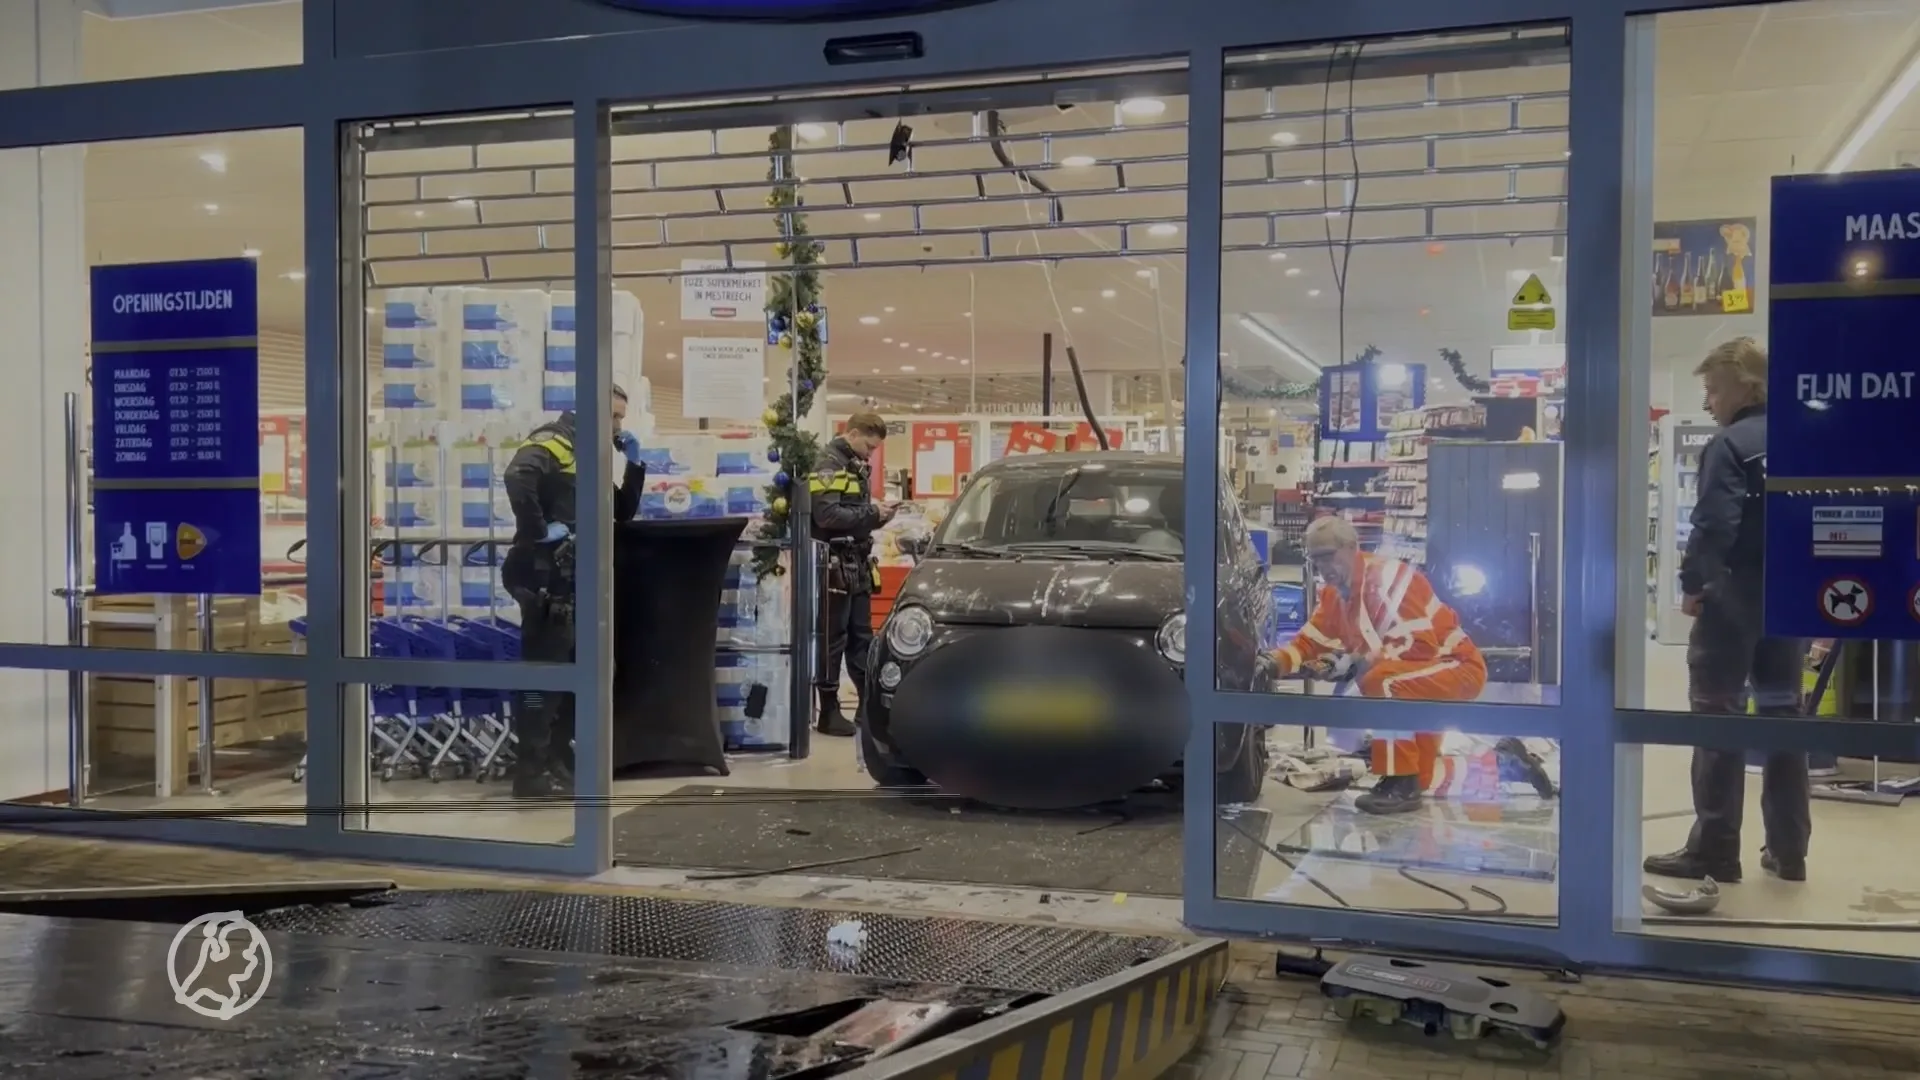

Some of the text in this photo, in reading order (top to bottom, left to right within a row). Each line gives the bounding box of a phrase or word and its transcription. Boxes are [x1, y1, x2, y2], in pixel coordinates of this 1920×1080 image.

[113, 289, 233, 313] OPENINGSTIJDEN
[694, 291, 703, 300] IN
[1797, 371, 1915, 400] FIJN DAT
